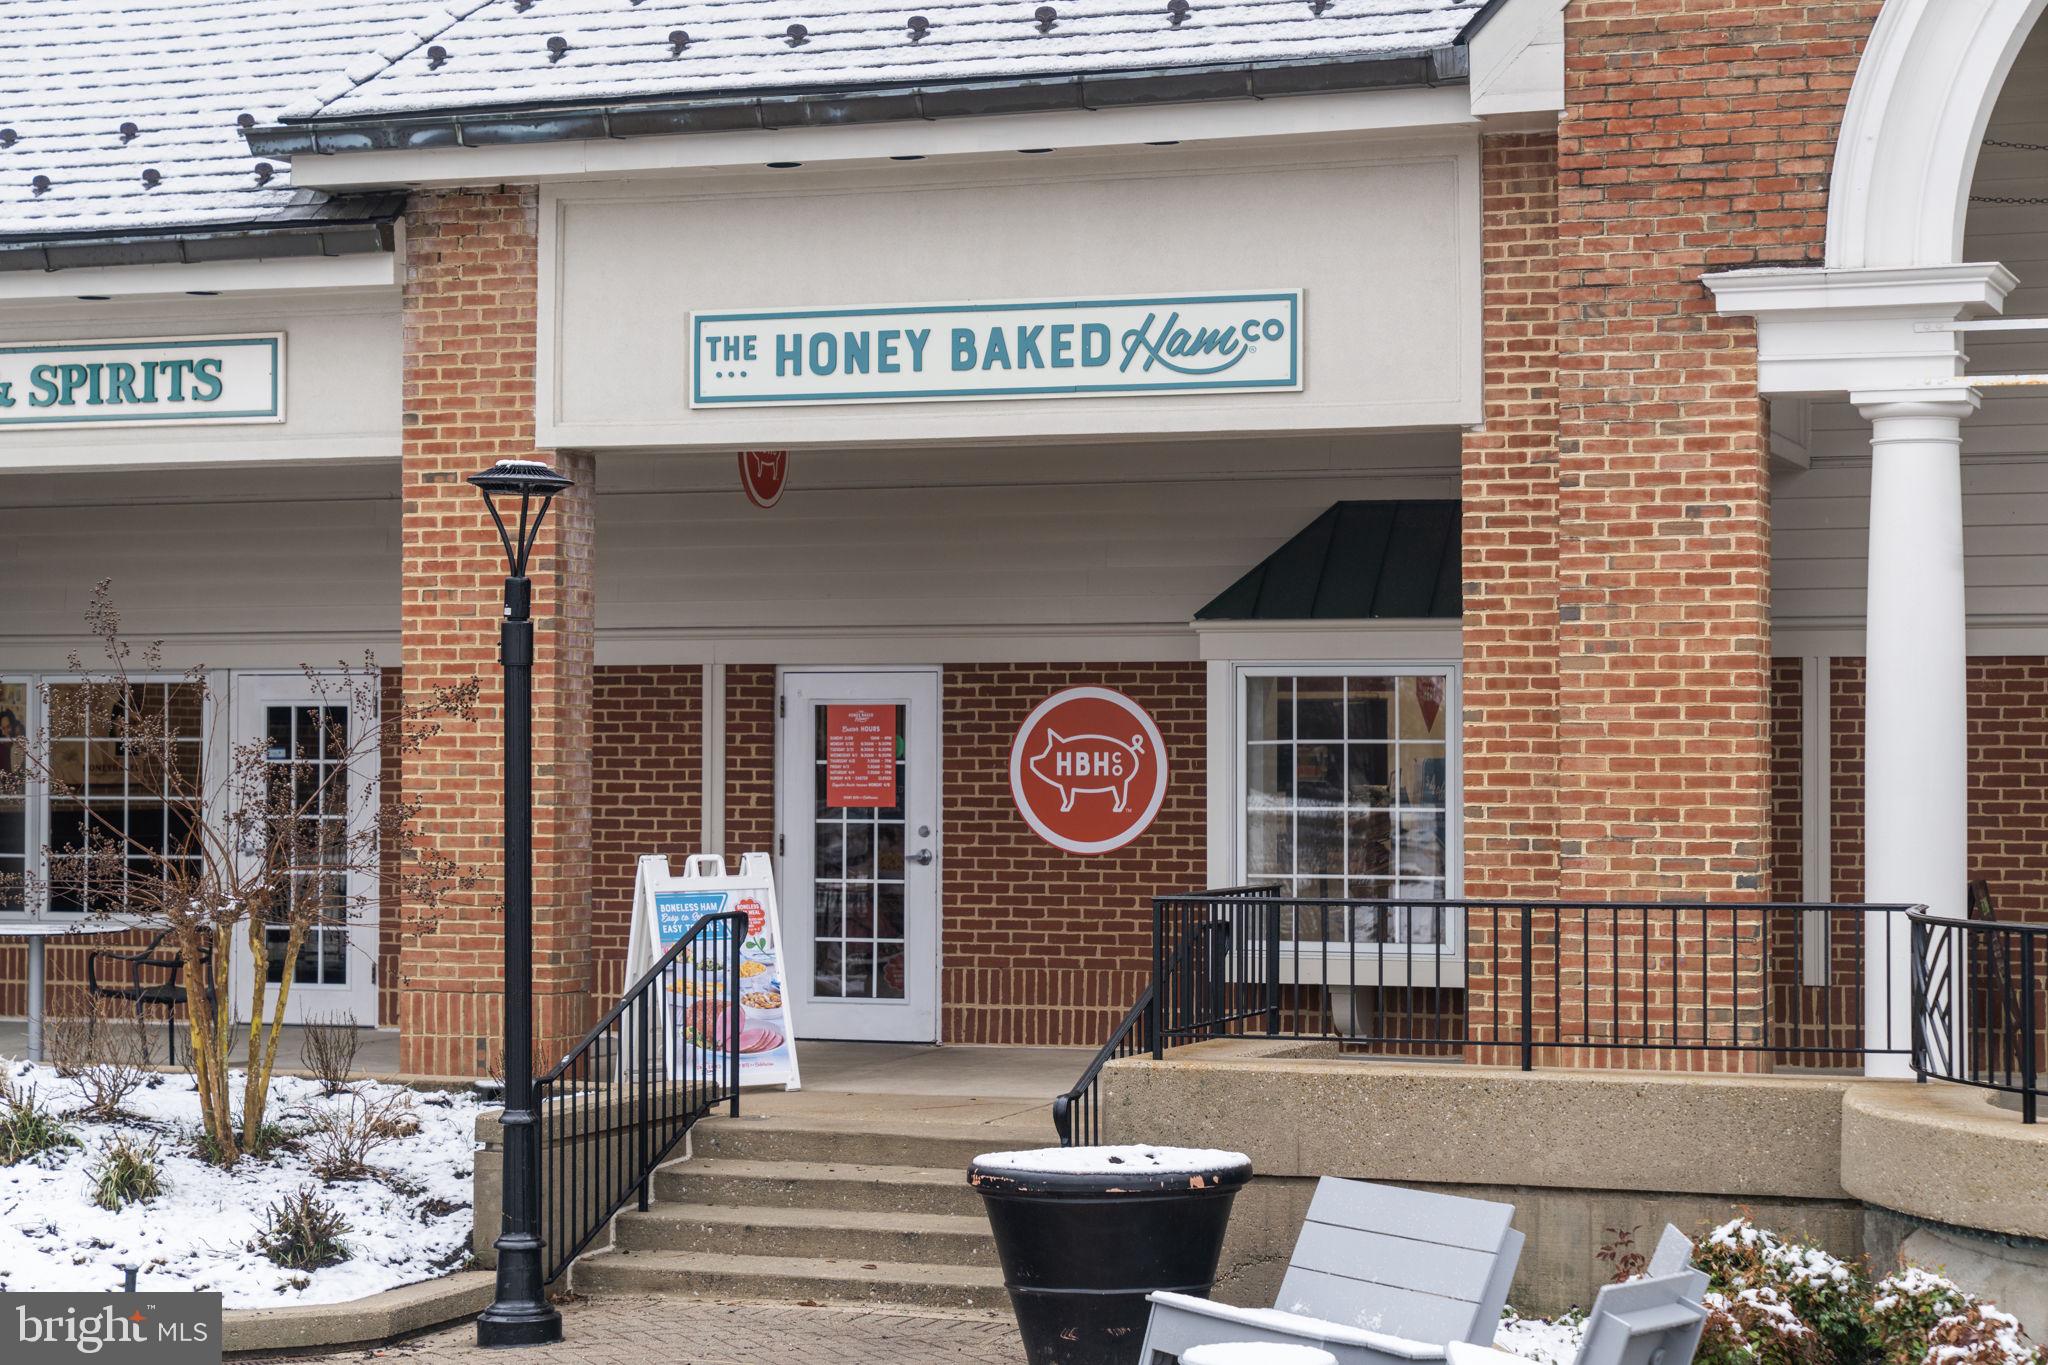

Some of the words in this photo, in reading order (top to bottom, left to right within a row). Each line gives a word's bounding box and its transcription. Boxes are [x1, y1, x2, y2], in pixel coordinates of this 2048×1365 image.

[705, 334, 757, 362] THE
[775, 328, 931, 377] HONEY
[950, 322, 1112, 371] BAKED
[1119, 311, 1248, 375] Ham
[28, 358, 223, 408] SPIRITS
[660, 903, 699, 913] BONELESS
[700, 902, 718, 911] HAM
[663, 923, 682, 934] EASY
